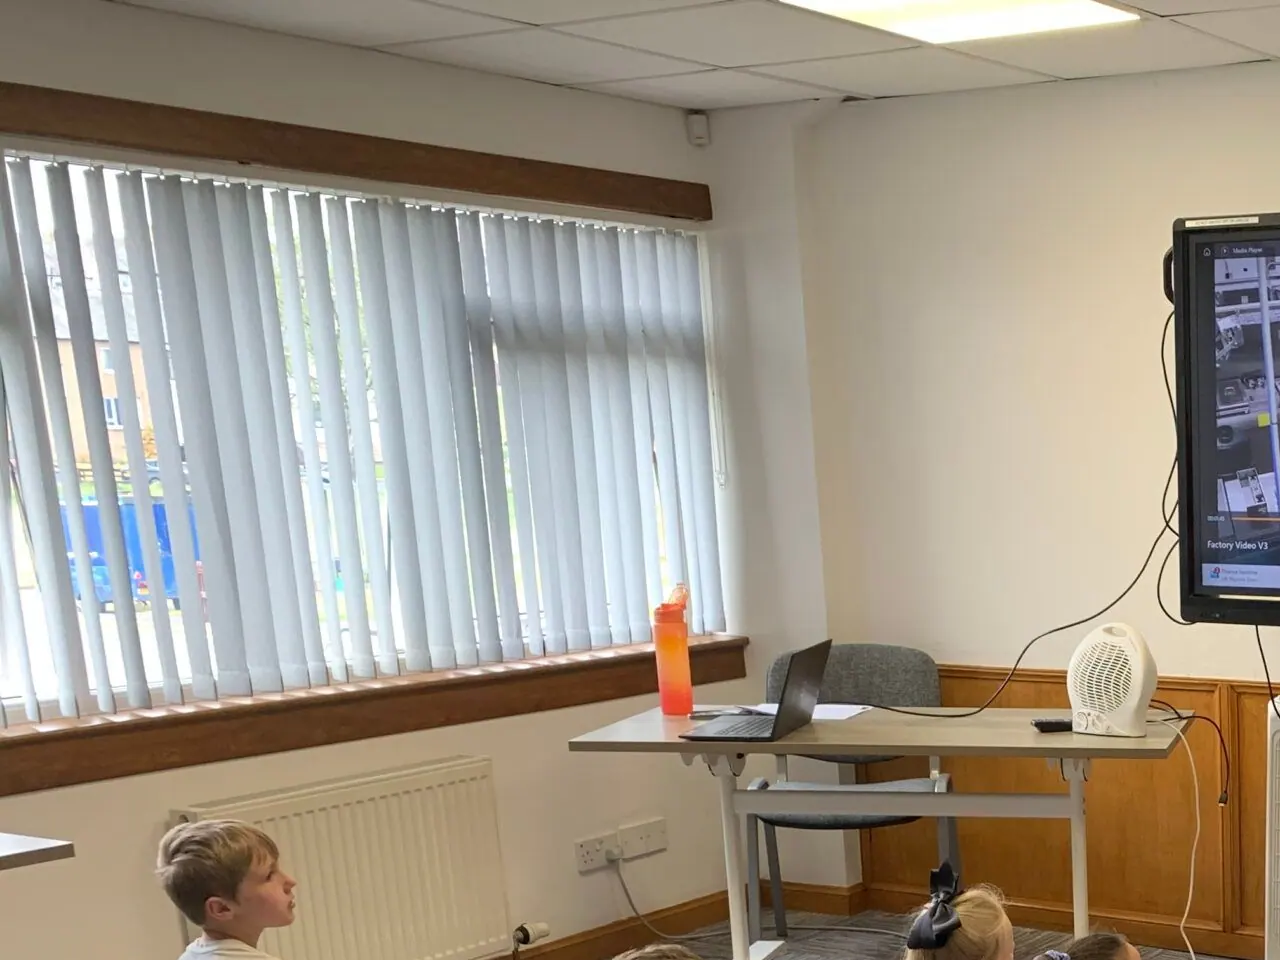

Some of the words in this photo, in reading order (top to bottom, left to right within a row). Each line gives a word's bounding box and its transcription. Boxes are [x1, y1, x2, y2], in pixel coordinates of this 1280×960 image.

[1207, 540, 1234, 551] Factory
[1235, 541, 1257, 550] Video
[1258, 542, 1269, 550] V3
